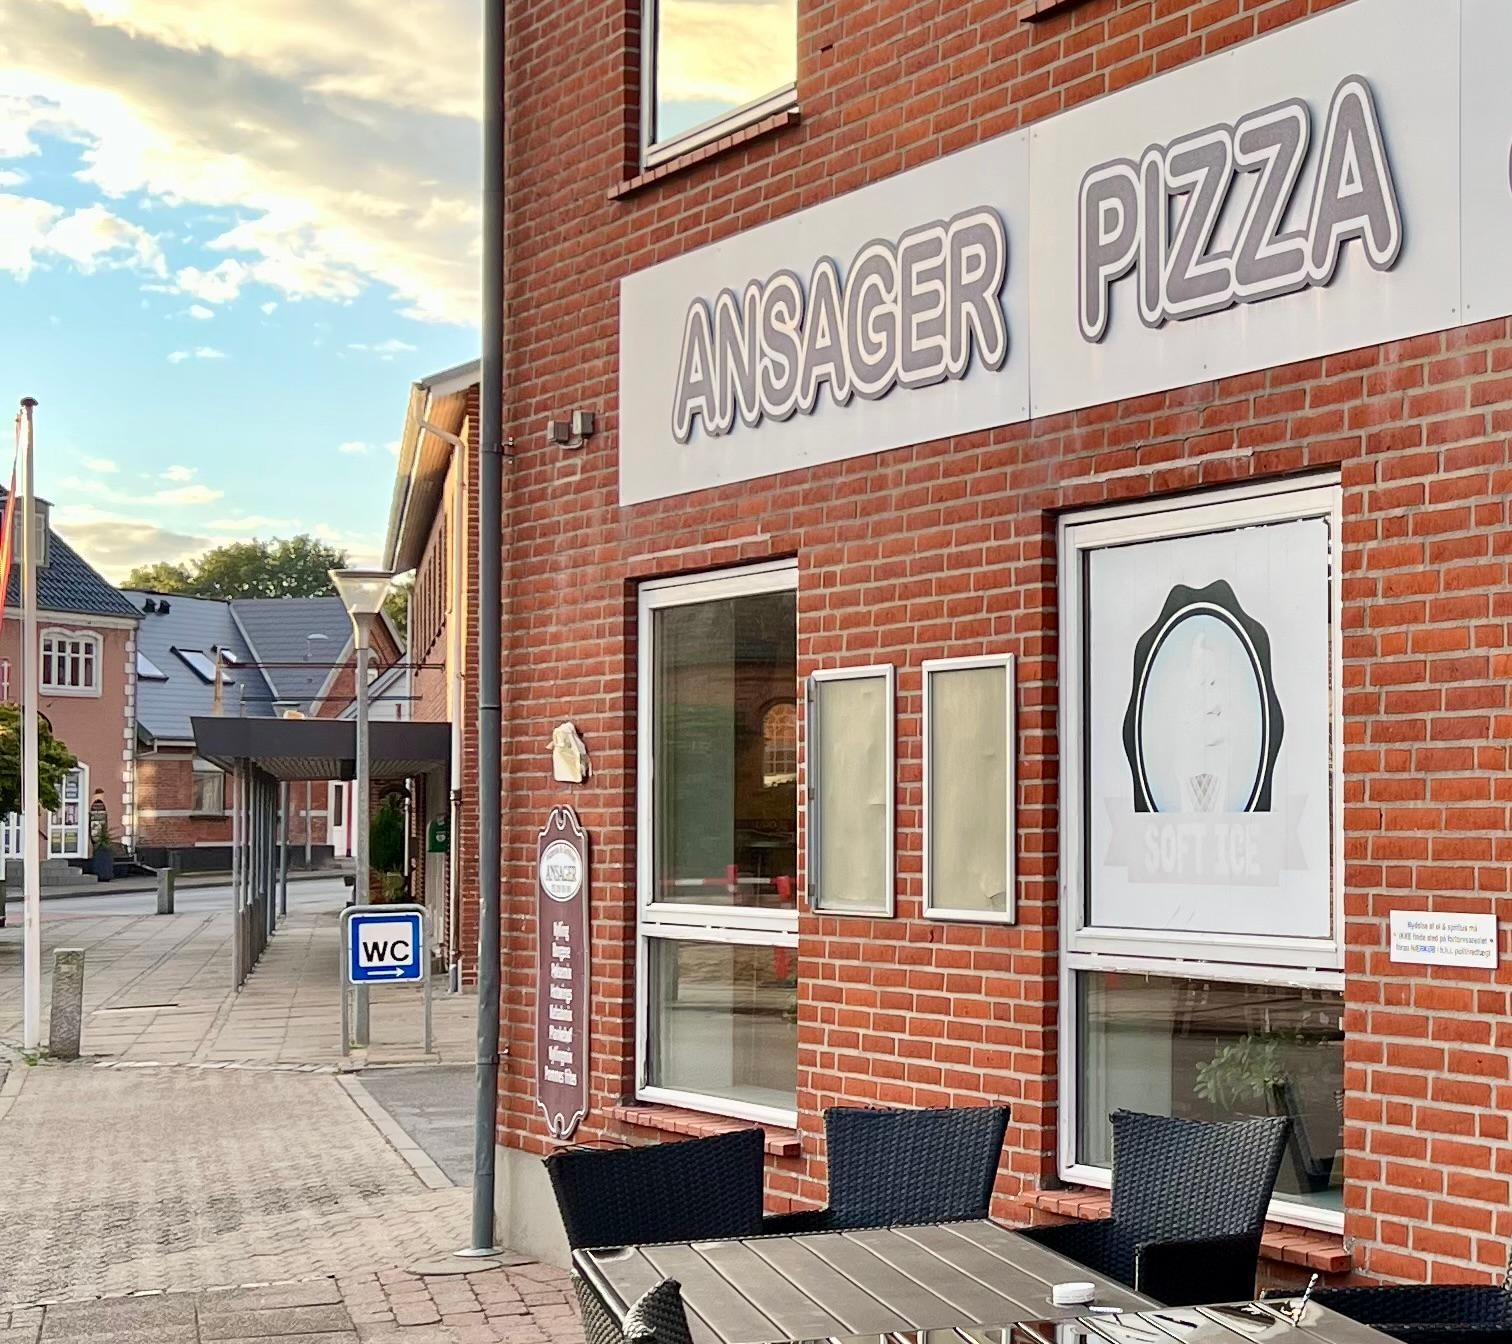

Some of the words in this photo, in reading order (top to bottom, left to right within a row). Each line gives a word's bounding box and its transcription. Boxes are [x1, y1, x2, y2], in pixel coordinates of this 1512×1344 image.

[672, 205, 1008, 445] ANSAGER
[1077, 73, 1403, 344] PIZZA
[1144, 822, 1209, 875] SOFT
[1214, 822, 1264, 876] ICE
[362, 940, 410, 962] WC
